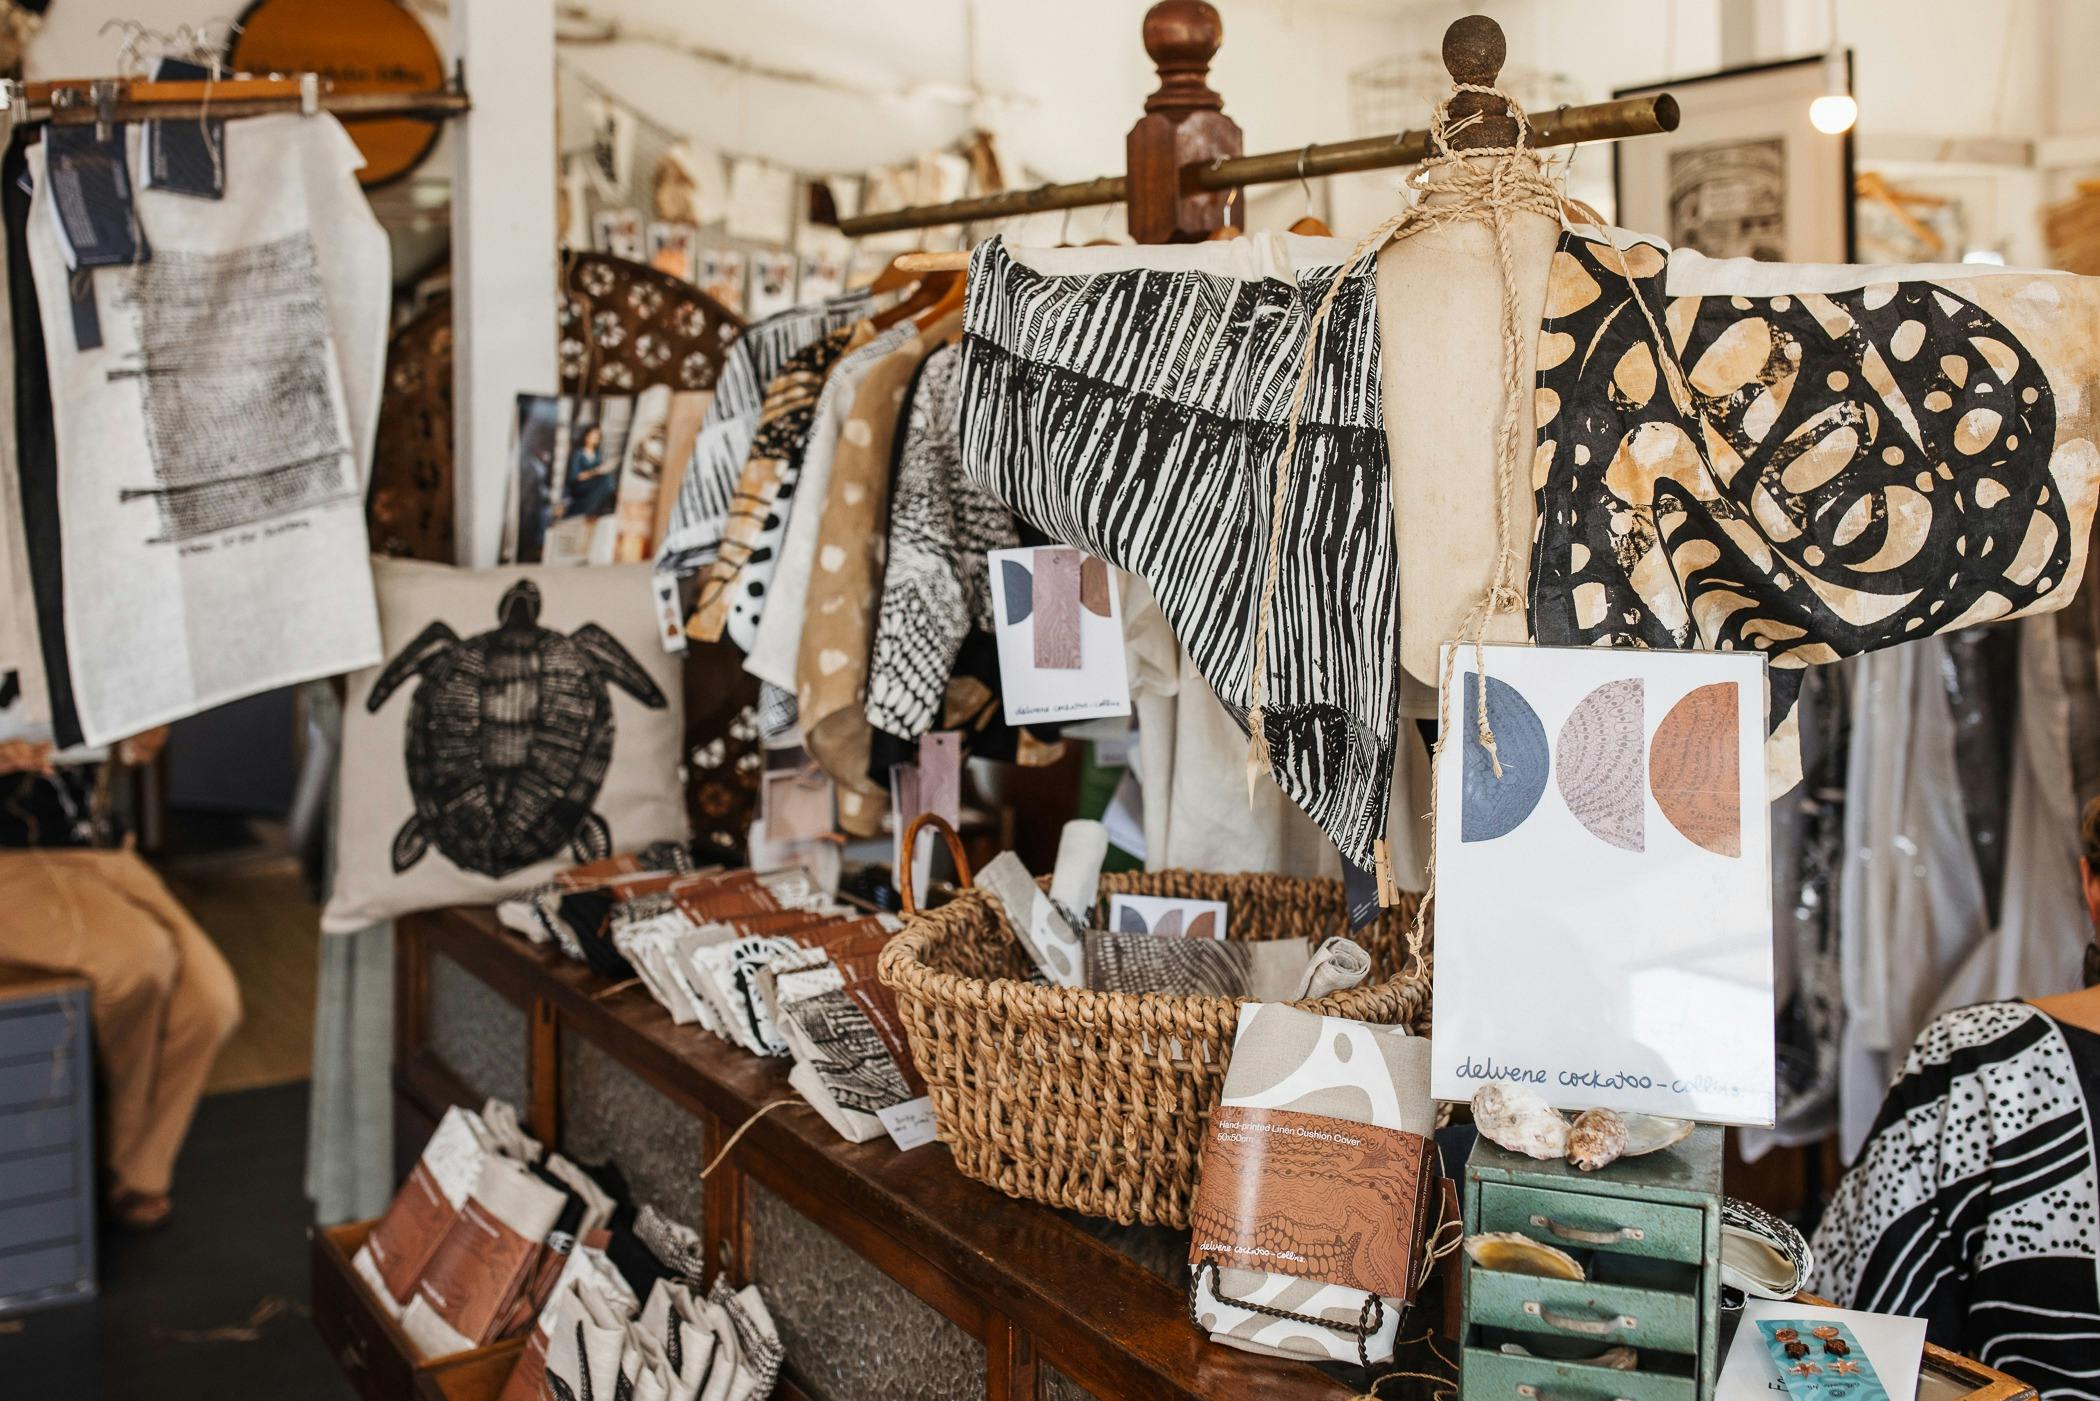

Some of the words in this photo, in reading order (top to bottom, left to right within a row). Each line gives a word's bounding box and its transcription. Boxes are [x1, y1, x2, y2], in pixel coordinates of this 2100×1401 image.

[1455, 1055, 1548, 1083] delvene
[1219, 1120, 1271, 1133] Hand-printed
[1271, 1125, 1295, 1136] Linen
[1296, 1127, 1332, 1142] Cushion
[1333, 1134, 1361, 1147] Cover
